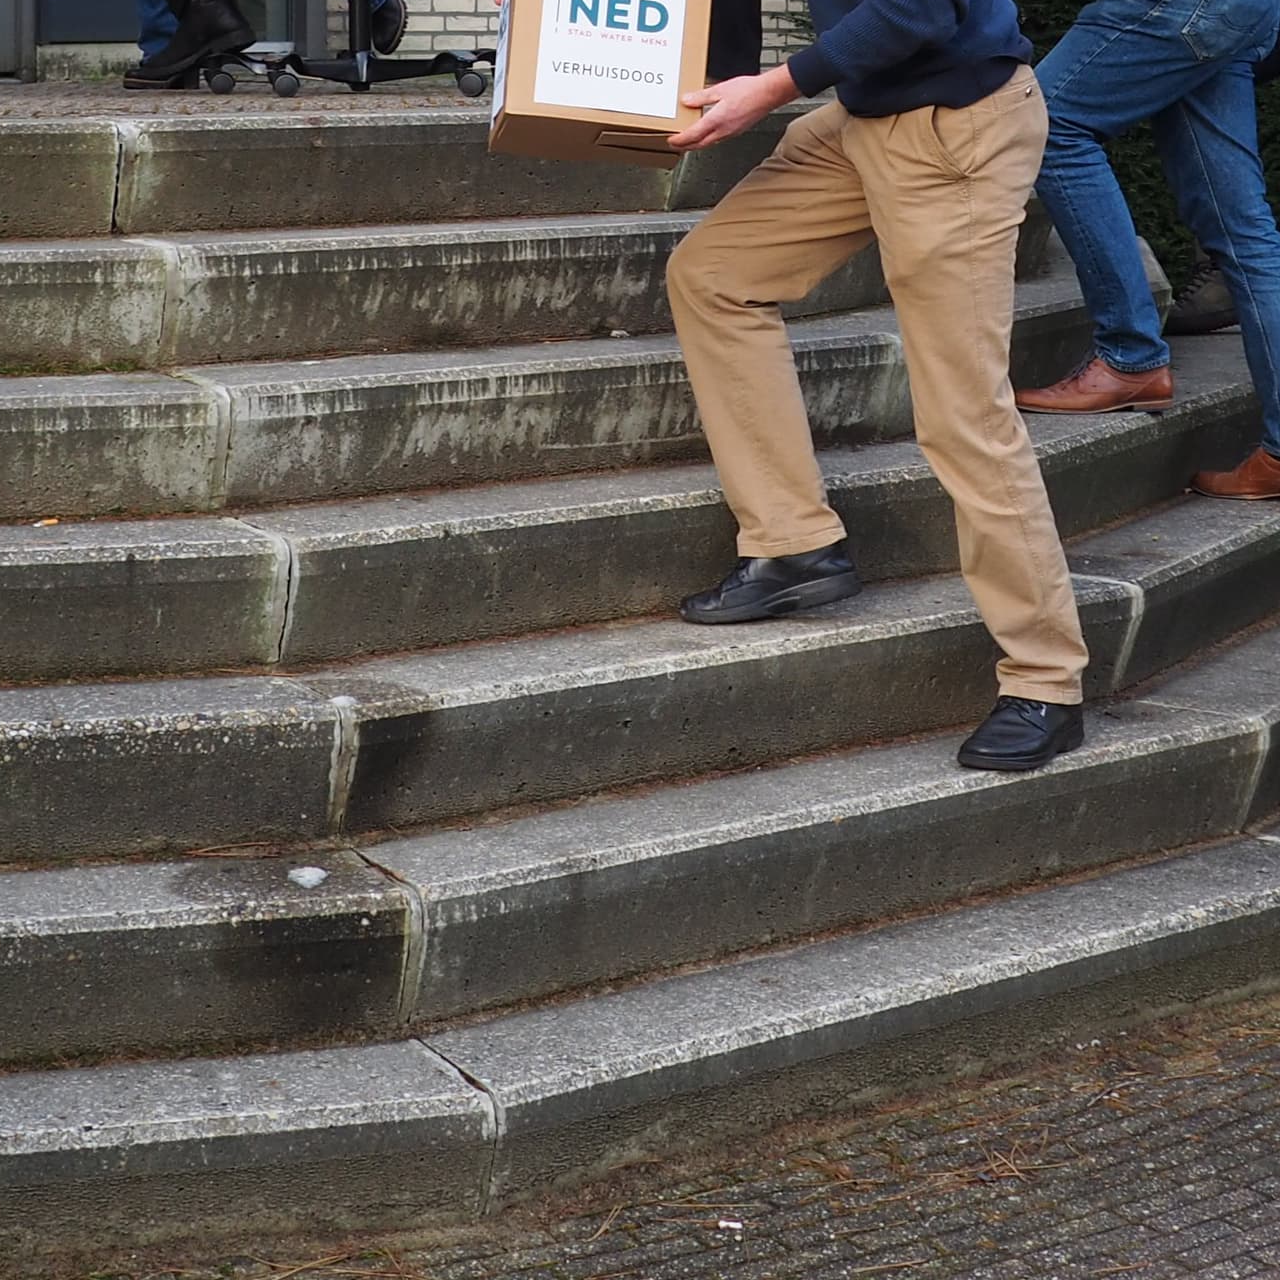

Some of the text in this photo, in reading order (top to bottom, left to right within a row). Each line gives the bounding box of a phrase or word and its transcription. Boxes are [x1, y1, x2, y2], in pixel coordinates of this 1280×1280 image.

[567, 28, 668, 47] STAD WATER MENS
[551, 60, 665, 86] VERHUISDOOS
